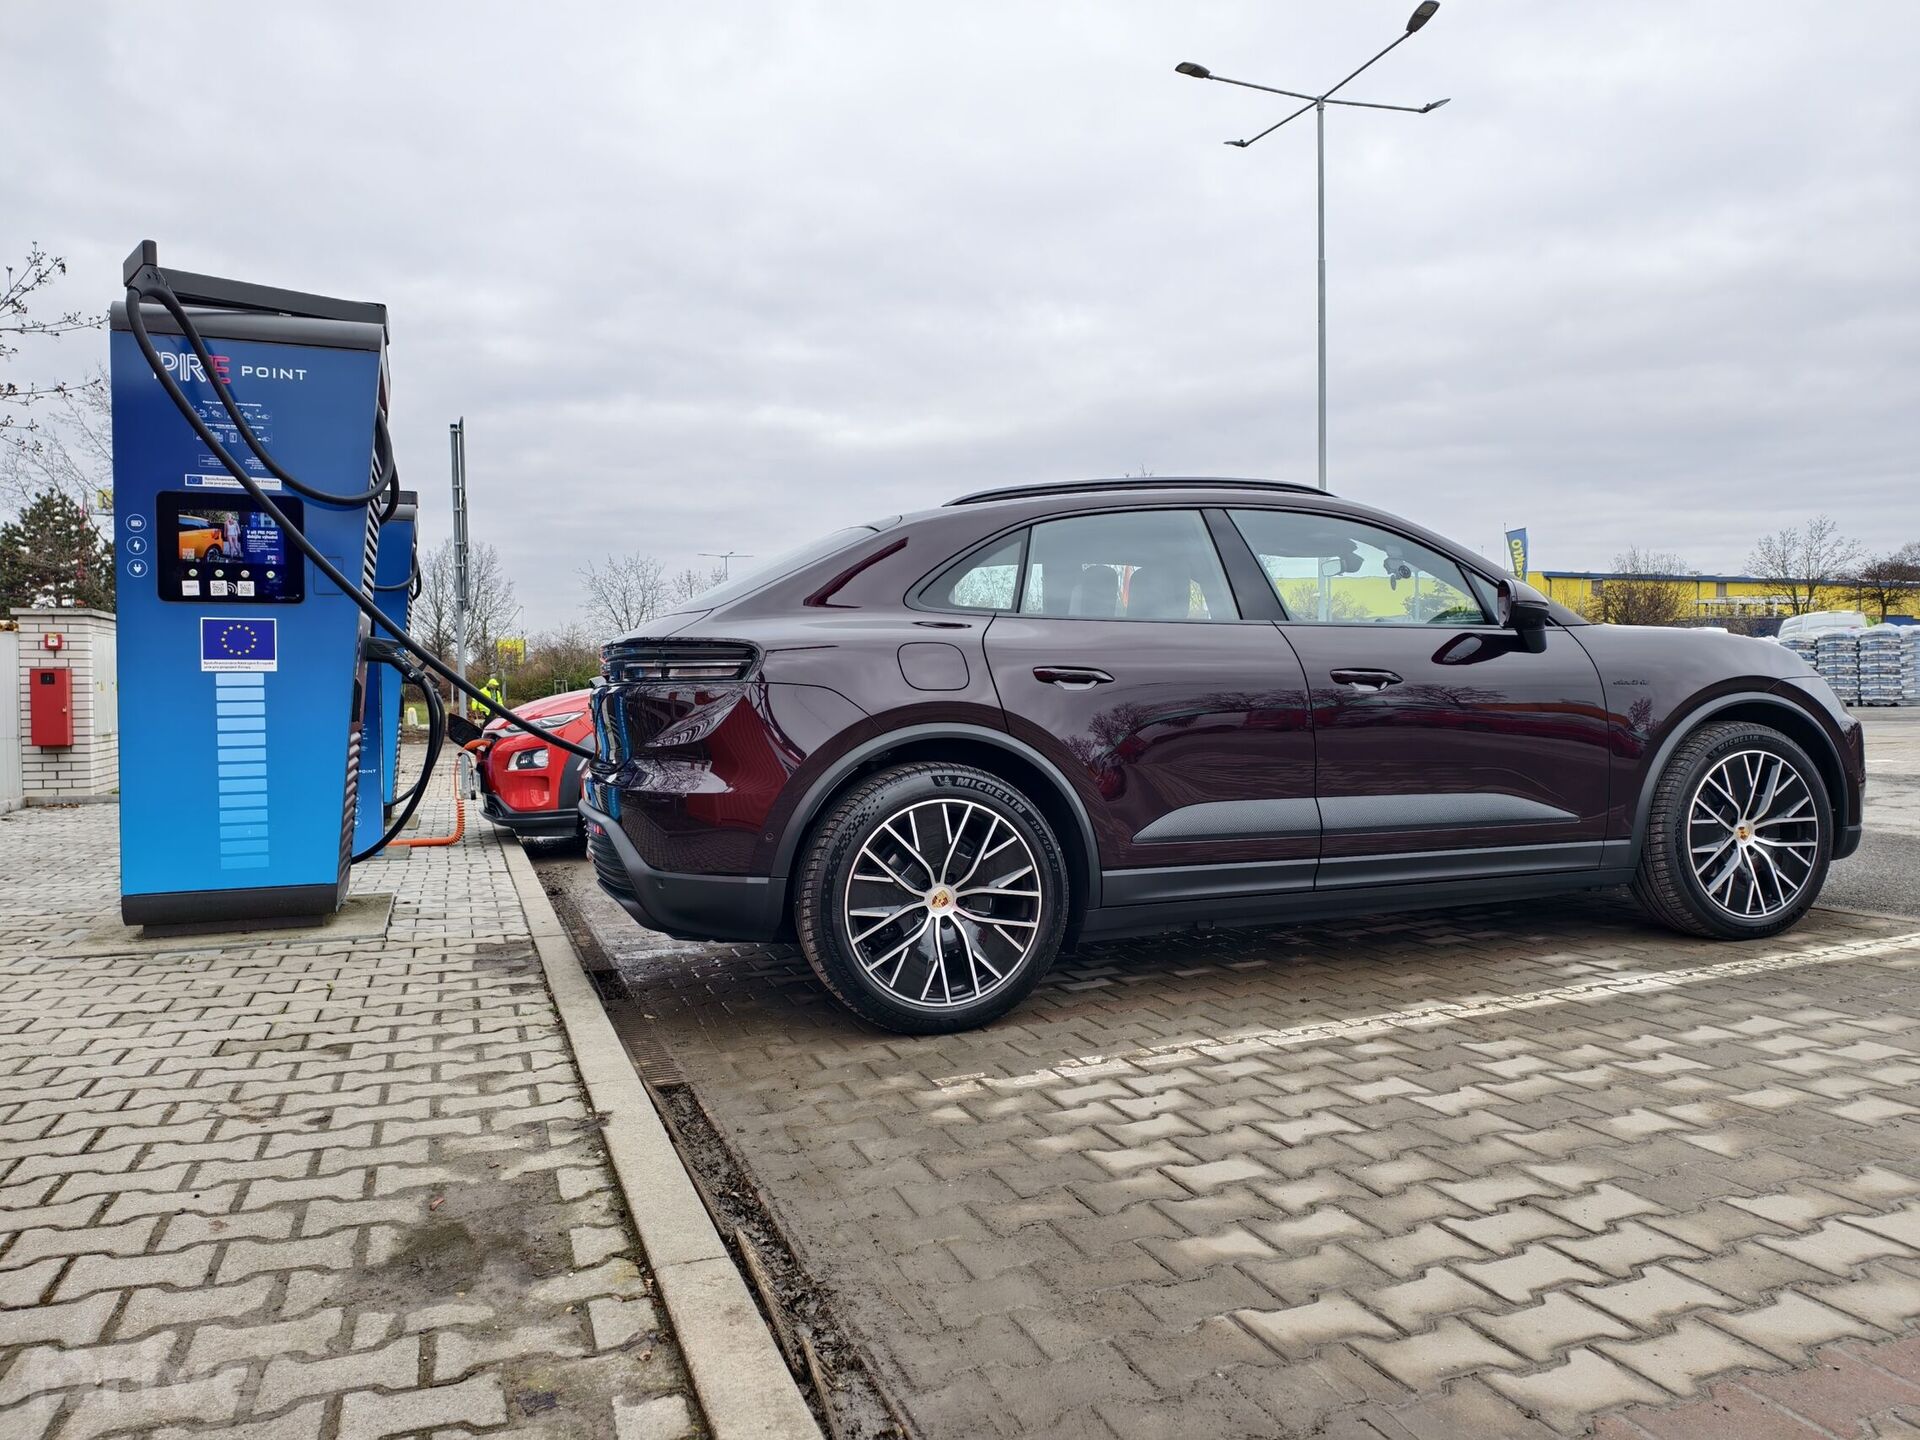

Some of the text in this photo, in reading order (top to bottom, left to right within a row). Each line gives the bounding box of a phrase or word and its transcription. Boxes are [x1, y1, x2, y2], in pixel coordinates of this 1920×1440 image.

[241, 365, 307, 381] POINT
[1718, 734, 1759, 750] MICHELIN
[955, 777, 1026, 814] MICHELIN
